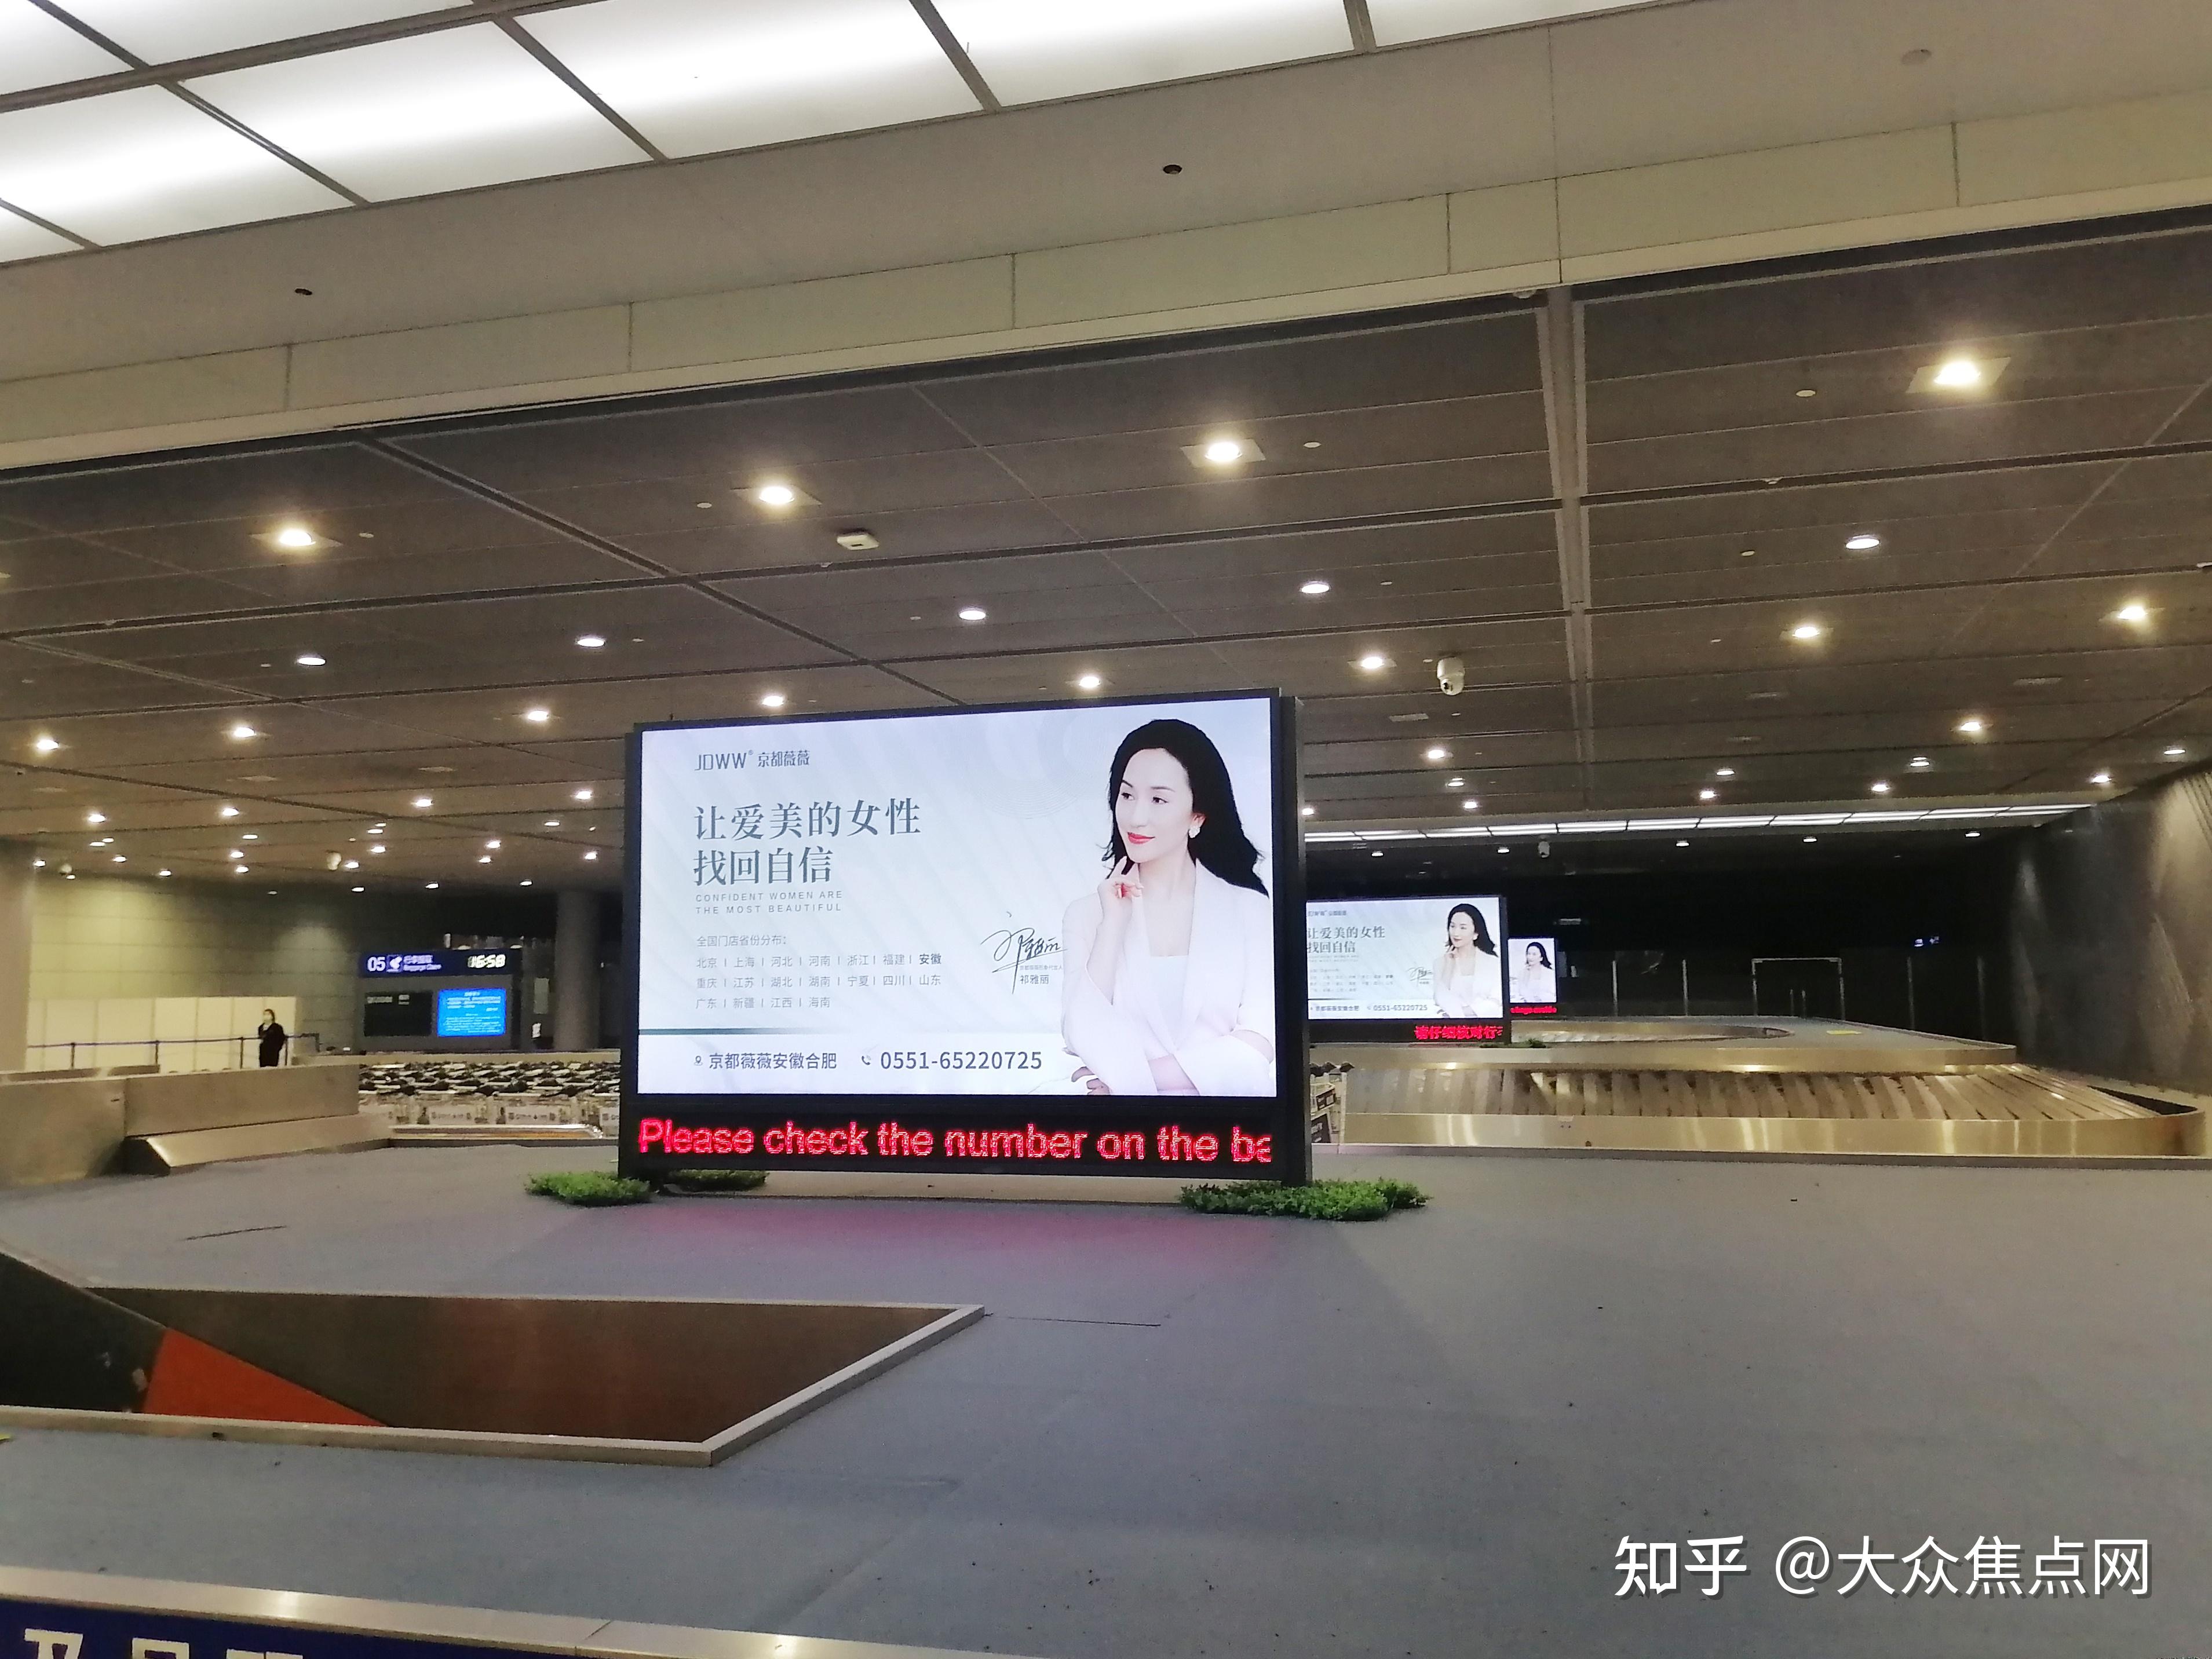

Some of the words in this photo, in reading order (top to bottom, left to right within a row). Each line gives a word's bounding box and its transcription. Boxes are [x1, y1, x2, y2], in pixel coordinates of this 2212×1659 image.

[758, 750, 811, 768] 京都薇薇
[694, 797, 921, 841] 让爱美的女性
[693, 846, 833, 886] 找回自信
[696, 893, 764, 902] CONFIDENT
[769, 891, 813, 901] WOMEN
[819, 890, 843, 899] ARE
[696, 905, 719, 914] THE
[727, 905, 761, 913] MOST
[768, 903, 841, 913] BEAUTIFUL
[1308, 926, 1385, 939] 让爱美的女性
[1307, 941, 1356, 953] 找回自信
[367, 957, 386, 971] 05
[697, 958, 717, 969] 北京
[919, 953, 941, 964] 安徽
[883, 975, 904, 986] 四川
[919, 974, 941, 985] 山东
[1020, 974, 1049, 984] 祁雅丽
[696, 998, 717, 1009] 广东
[771, 997, 792, 1008] 江西
[709, 1053, 837, 1070] 京都薇薇安徽合肥
[881, 1051, 1042, 1070] 0551-65220725
[639, 1118, 754, 1154] Please
[764, 1120, 869, 1156] check
[877, 1121, 935, 1156] the
[944, 1123, 1089, 1159] number
[1097, 1134, 1144, 1160] on
[1157, 1125, 1218, 1161] the
